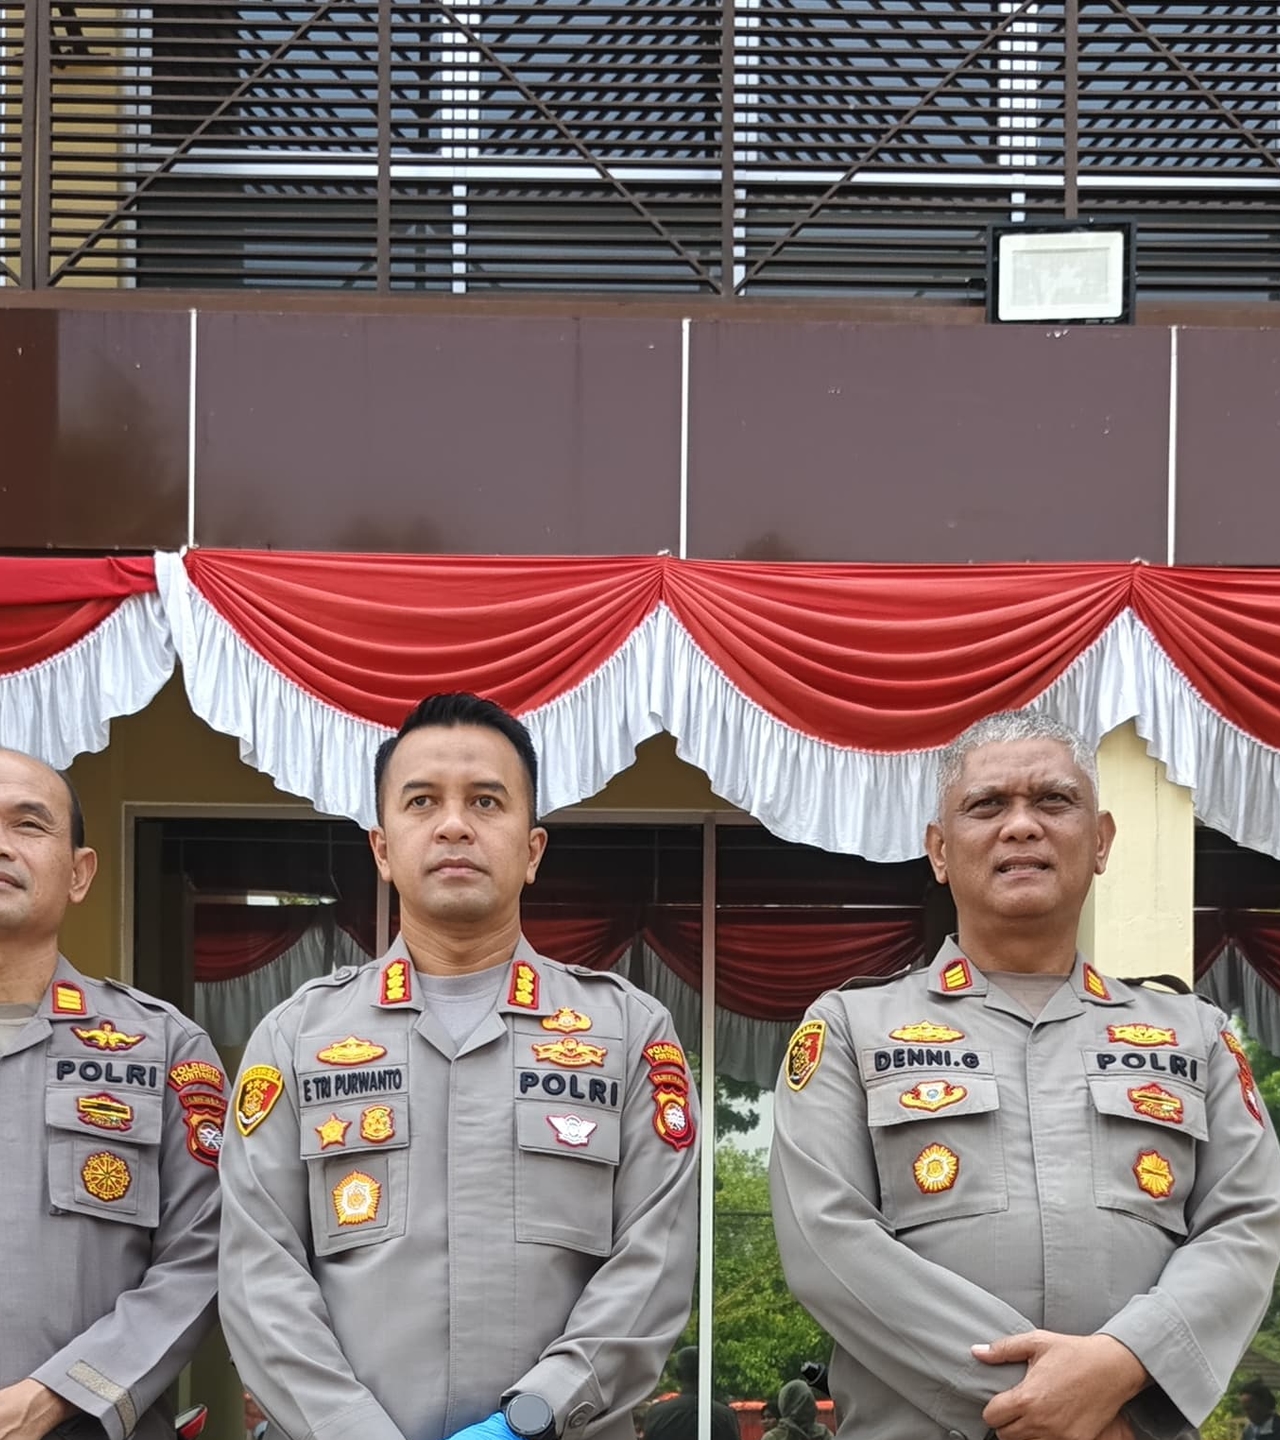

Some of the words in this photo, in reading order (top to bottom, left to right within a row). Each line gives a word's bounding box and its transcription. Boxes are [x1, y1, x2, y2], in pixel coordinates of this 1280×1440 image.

[56, 1060, 158, 1088] POLRI
[874, 1048, 980, 1072] DENNI.G
[1096, 1053, 1198, 1082] POLRI
[303, 1079, 312, 1102] E
[312, 1075, 331, 1100] TRI
[334, 1068, 402, 1096] PURWANTO
[519, 1072, 618, 1107] POLRI
